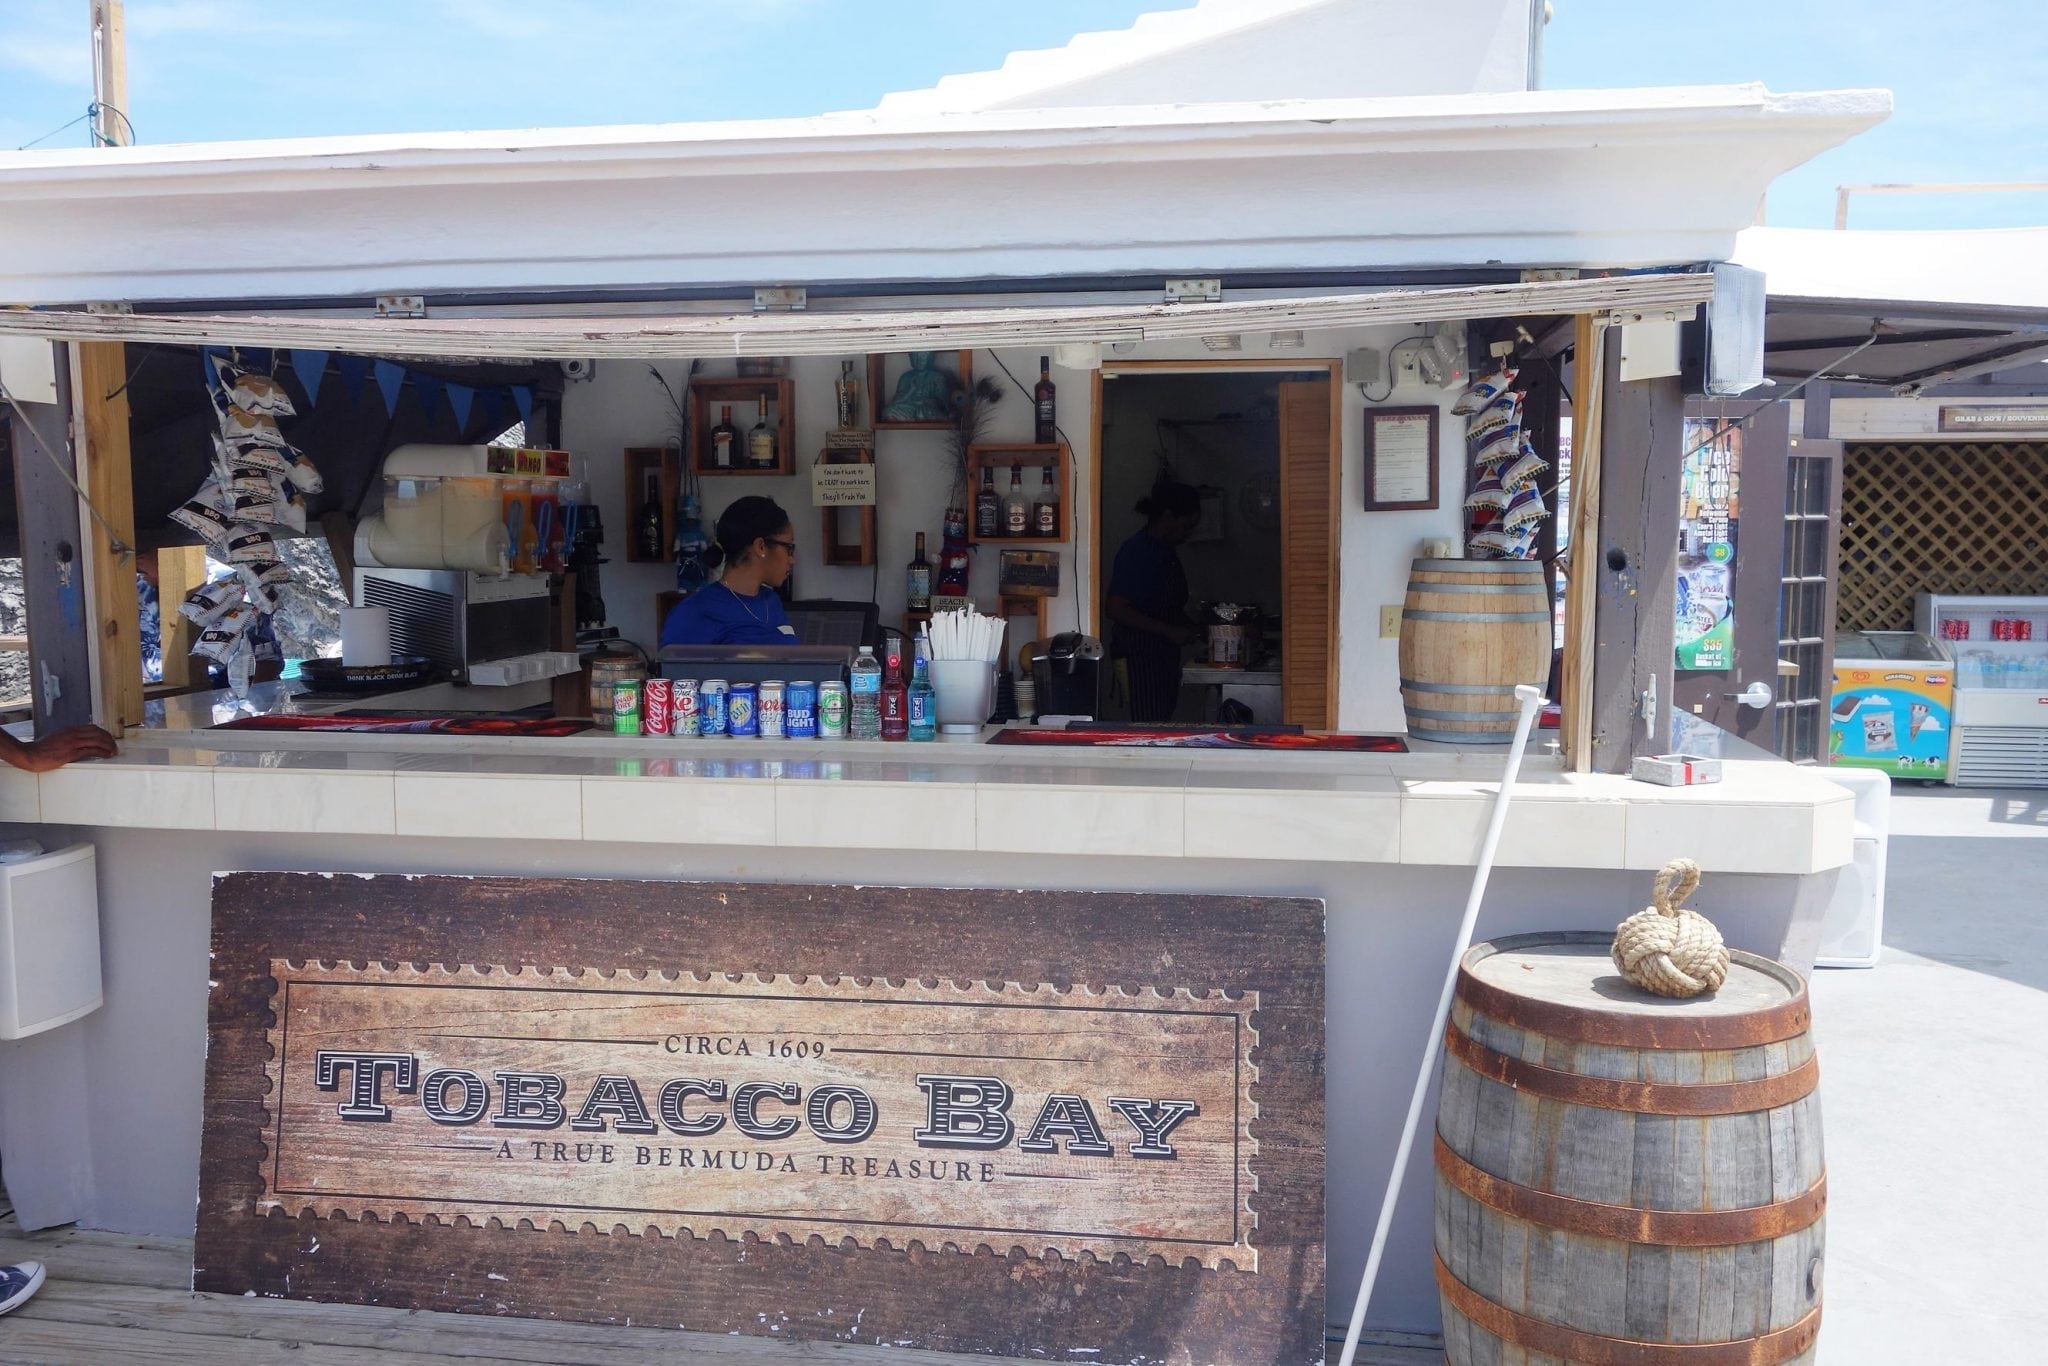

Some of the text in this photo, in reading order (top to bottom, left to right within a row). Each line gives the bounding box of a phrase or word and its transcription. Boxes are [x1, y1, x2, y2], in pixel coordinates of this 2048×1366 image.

[1709, 448, 1731, 465] Ice
[1700, 465, 1730, 482] Cold
[1696, 483, 1729, 499] Beer
[787, 709, 810, 718] BUD
[889, 697, 897, 715] WKD
[914, 700, 922, 717] WKD
[786, 718, 815, 727] LIGHT
[665, 1034, 825, 1059] CIRCA 1609
[316, 1049, 1201, 1160] TOBACCO BAY
[496, 1140, 996, 1183] A TRUE BERMUDA TREASURE
